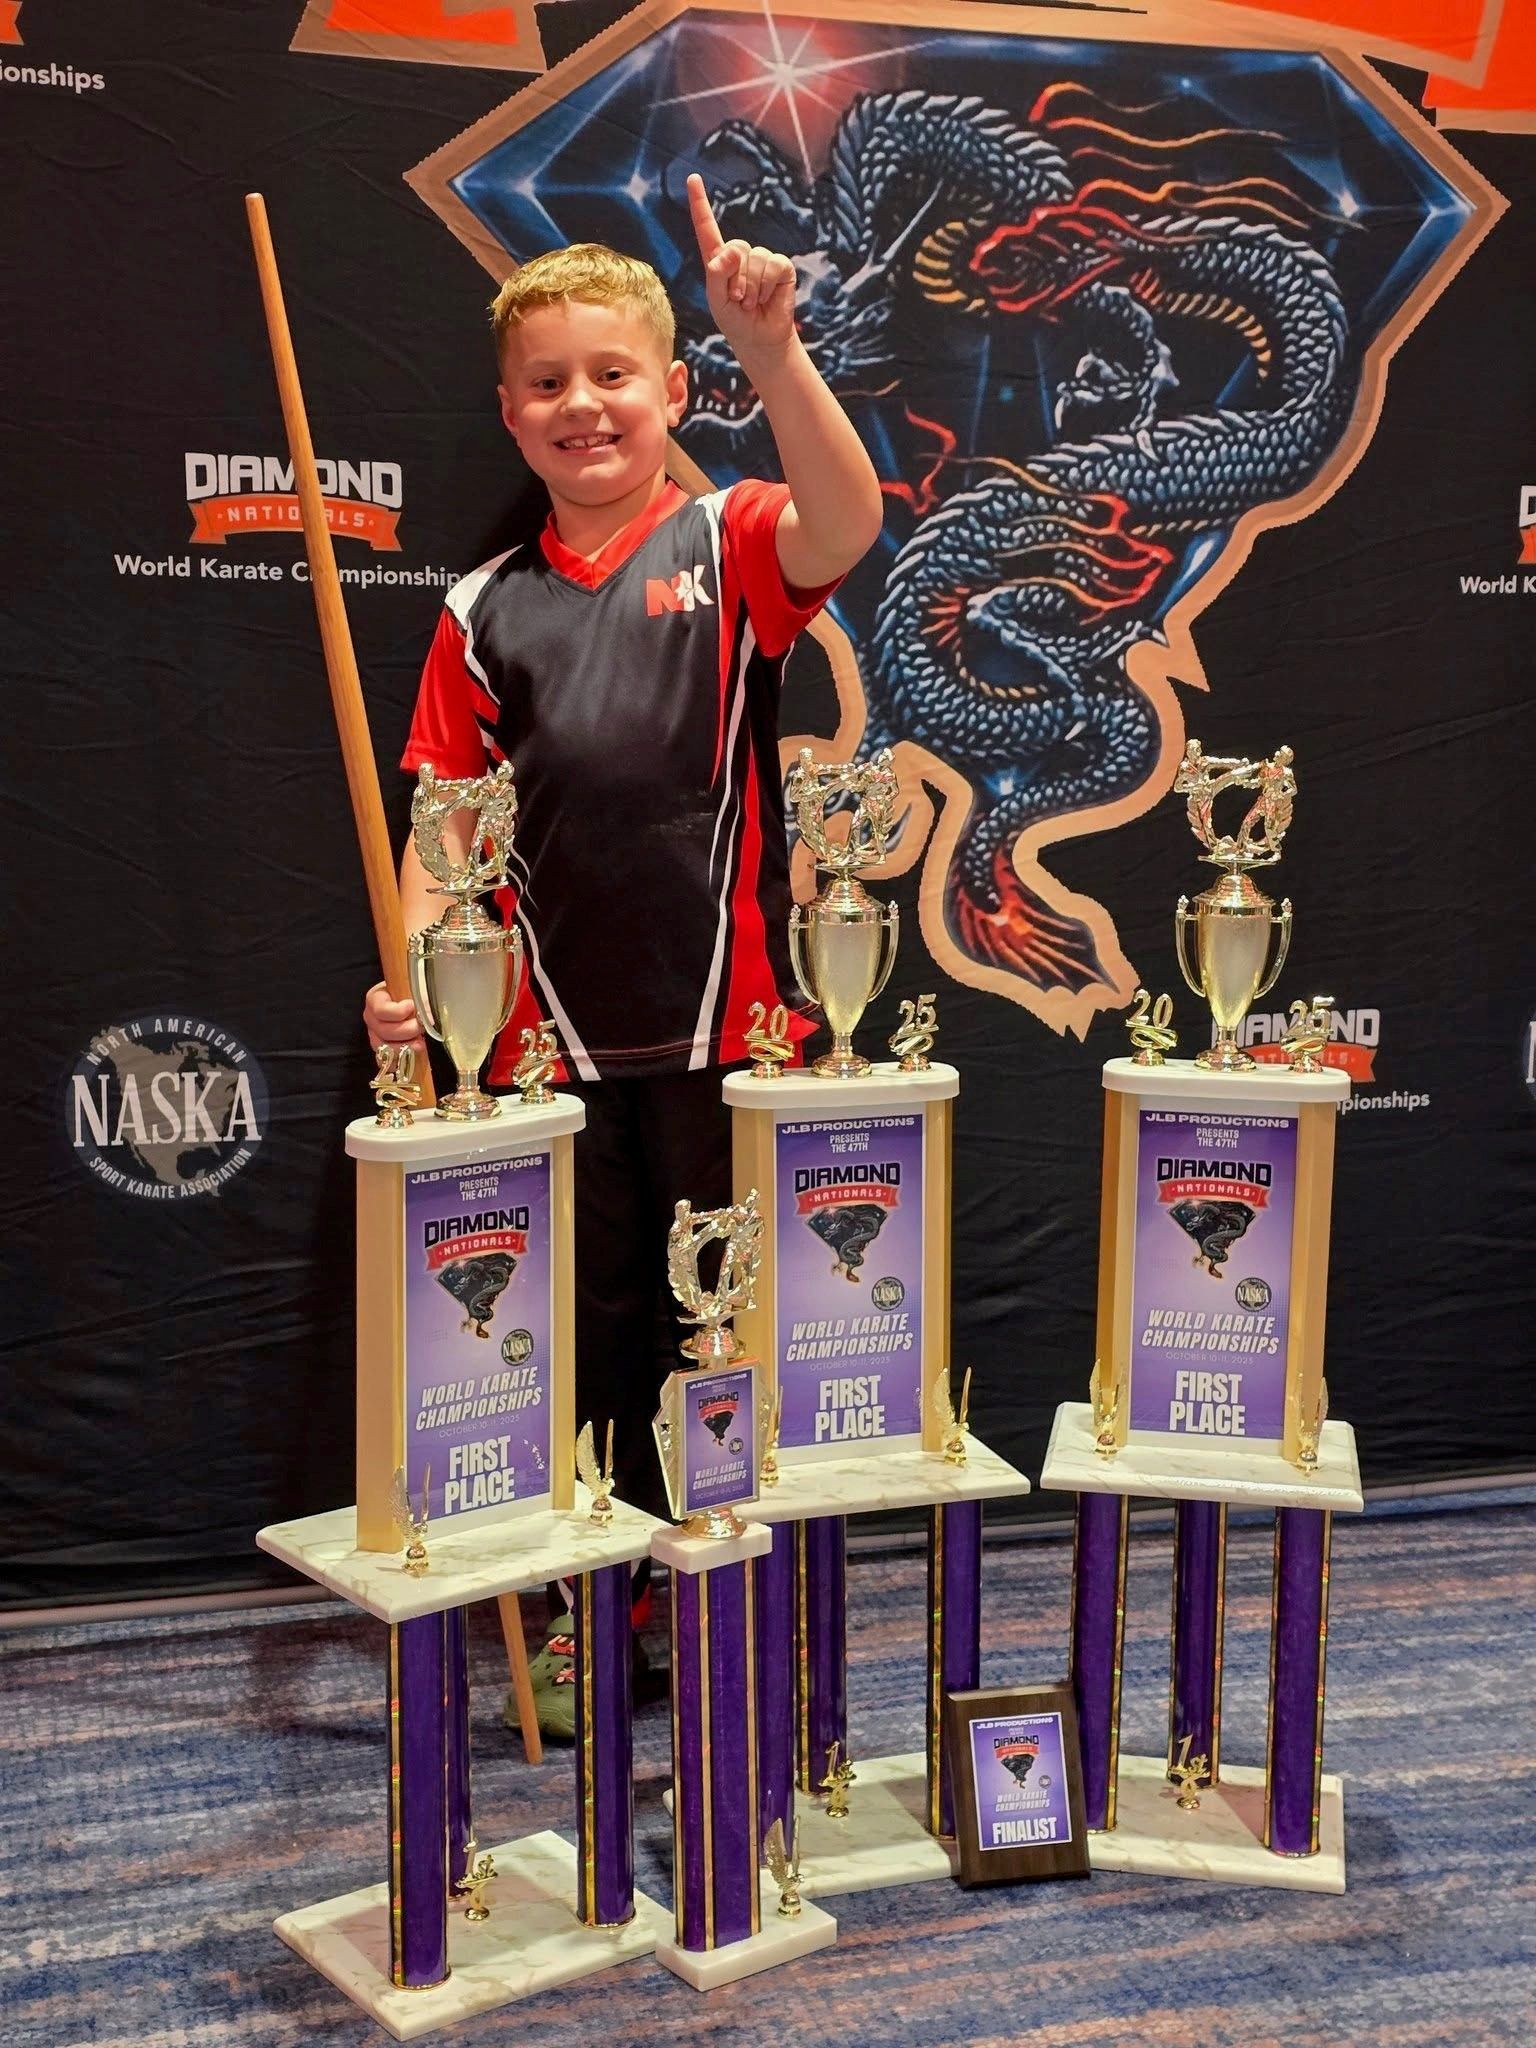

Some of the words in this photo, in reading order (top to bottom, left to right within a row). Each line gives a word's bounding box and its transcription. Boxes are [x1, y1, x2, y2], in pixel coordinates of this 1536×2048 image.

[185, 452, 403, 508] DIAMOND
[227, 504, 365, 528] NATIOALS
[114, 554, 190, 578] World
[200, 558, 283, 582] Karate
[291, 561, 467, 591] Cmpionship
[1460, 575, 1517, 594] World
[745, 1002, 789, 1040] 20
[897, 993, 937, 1033] 25
[1130, 988, 1174, 1030] 20
[1288, 996, 1335, 1033] 25
[87, 1023, 142, 1066] NORTH
[154, 1018, 247, 1064] AMERICAN
[519, 1019, 558, 1058] 25
[373, 1044, 416, 1084] 20
[72, 1071, 262, 1147] NASKA
[1146, 1113, 1176, 1122] JLB
[1178, 1114, 1290, 1128] PRODUCTIONS
[782, 1123, 811, 1134] JLB
[812, 1117, 915, 1132] PRODUCTIONS
[829, 1133, 870, 1144] PRESENTS
[1196, 1128, 1239, 1139] PRESENTS
[831, 1143, 847, 1153] THE
[847, 1142, 868, 1152] 47TH
[1198, 1137, 1214, 1147] THE
[1215, 1138, 1237, 1148] 47TH
[89, 1156, 126, 1187] SPORT
[127, 1178, 175, 1198] KARATE
[180, 1148, 252, 1197] ASSOCIATION
[411, 1172, 440, 1184] JLB
[442, 1156, 543, 1180] PRODUCTIONS
[459, 1176, 499, 1191] PRESENTS
[795, 1162, 901, 1194] DIAMOND
[1157, 1158, 1272, 1187] DIAMOND
[461, 1190, 476, 1201] THE
[477, 1187, 498, 1199] 47TH
[814, 1188, 882, 1202] NATIONALS
[1176, 1183, 1250, 1197] NATIONALS
[424, 1206, 529, 1248] DIAMOND
[444, 1235, 512, 1256] NATIONALS
[873, 1286, 903, 1302] NASKA
[1237, 1286, 1269, 1303] NASKA
[792, 1319, 845, 1341] WORLD
[850, 1313, 909, 1335] KARATE
[1148, 1309, 1206, 1330] WORLD
[1210, 1313, 1275, 1335] KARATE
[502, 1337, 533, 1358] NASKA
[786, 1332, 913, 1362] CHAMPIONSHIPS
[1141, 1329, 1280, 1355] CHAMPIONSHIPS
[421, 1379, 476, 1408] WORLD
[480, 1366, 538, 1396] KARATE
[698, 1391, 739, 1409] DIAMOND
[820, 1375, 881, 1410] FIRST
[1175, 1370, 1242, 1404] FIRST
[415, 1387, 543, 1431] CHAMPIONSHIPS
[1169, 1400, 1246, 1436] PLACE
[815, 1405, 885, 1442] PLACE
[449, 1435, 511, 1480] FIRST
[444, 1467, 515, 1514] PLACE
[995, 1717, 1054, 1727] PRODUCTIONS
[993, 1735, 1039, 1749] DIAMOND
[992, 1817, 1057, 1844] FINALIST
